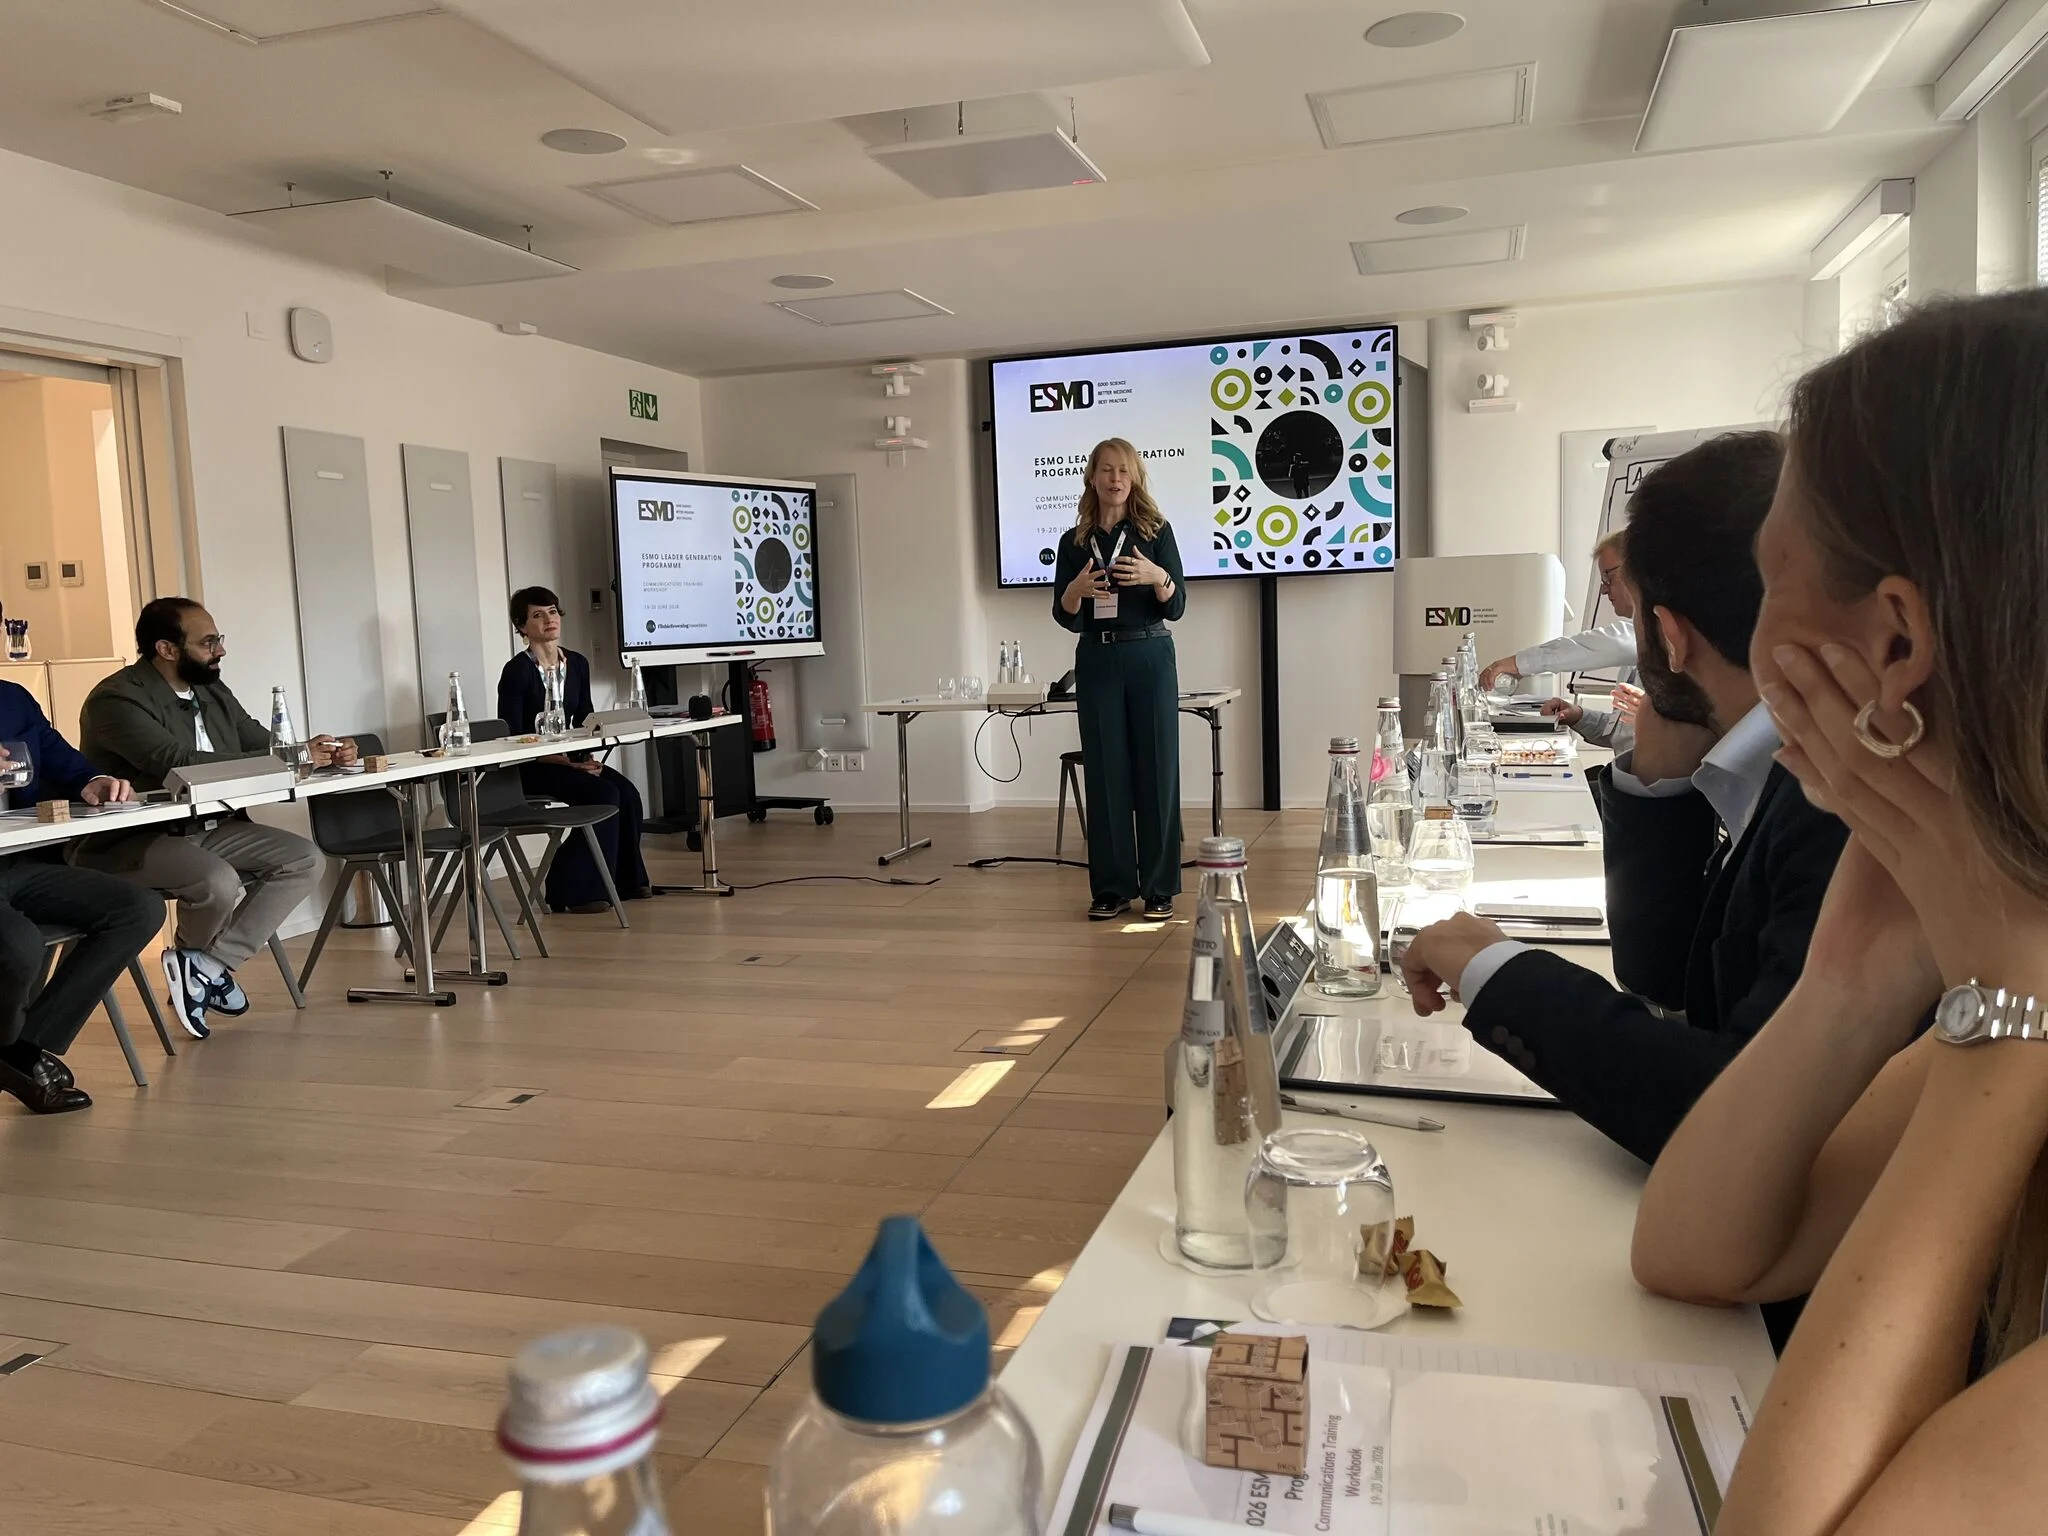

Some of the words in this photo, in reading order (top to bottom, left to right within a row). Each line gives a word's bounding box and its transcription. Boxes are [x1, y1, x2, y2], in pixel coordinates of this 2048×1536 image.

[1030, 380, 1094, 412] ESMO
[1034, 456, 1064, 466] ESMO
[1068, 454, 1088, 464] LEA
[638, 499, 674, 521] ESMO
[1035, 502, 1079, 511] WORKSHOP
[1425, 606, 1471, 627] ESMO
[1322, 1414, 1342, 1448] Training
[1250, 1472, 1272, 1499] ESM
[1345, 1448, 1363, 1499] Workbook
[1315, 1450, 1337, 1533] Communications
[1246, 1501, 1267, 1527] 026
